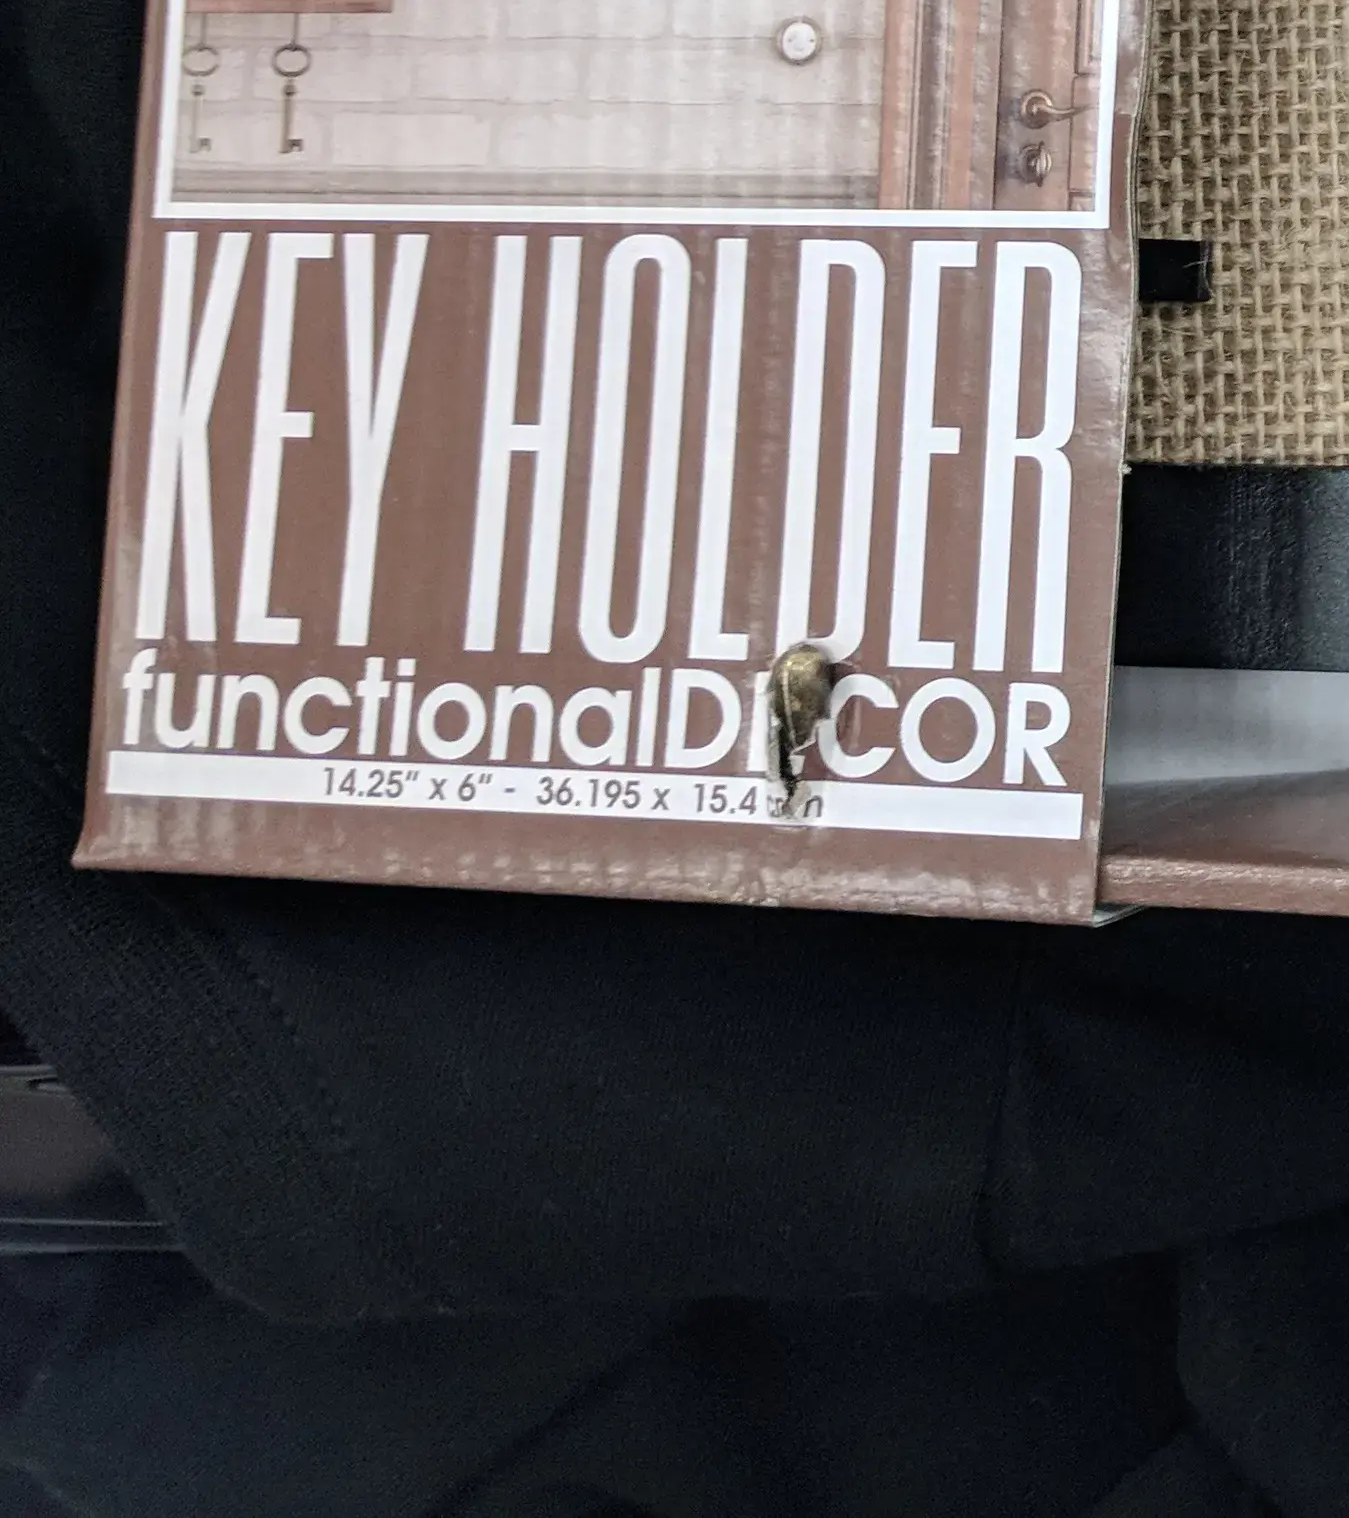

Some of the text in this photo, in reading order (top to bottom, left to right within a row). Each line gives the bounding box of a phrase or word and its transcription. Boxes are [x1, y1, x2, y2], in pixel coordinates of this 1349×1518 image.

[134, 231, 1083, 674] KEY HOLDER
[322, 766, 418, 799] 14.25"
[428, 778, 447, 801] x
[456, 774, 492, 802] 6"
[535, 775, 641, 810] 36.195
[652, 787, 670, 811] x
[694, 783, 758, 816] 15.4
